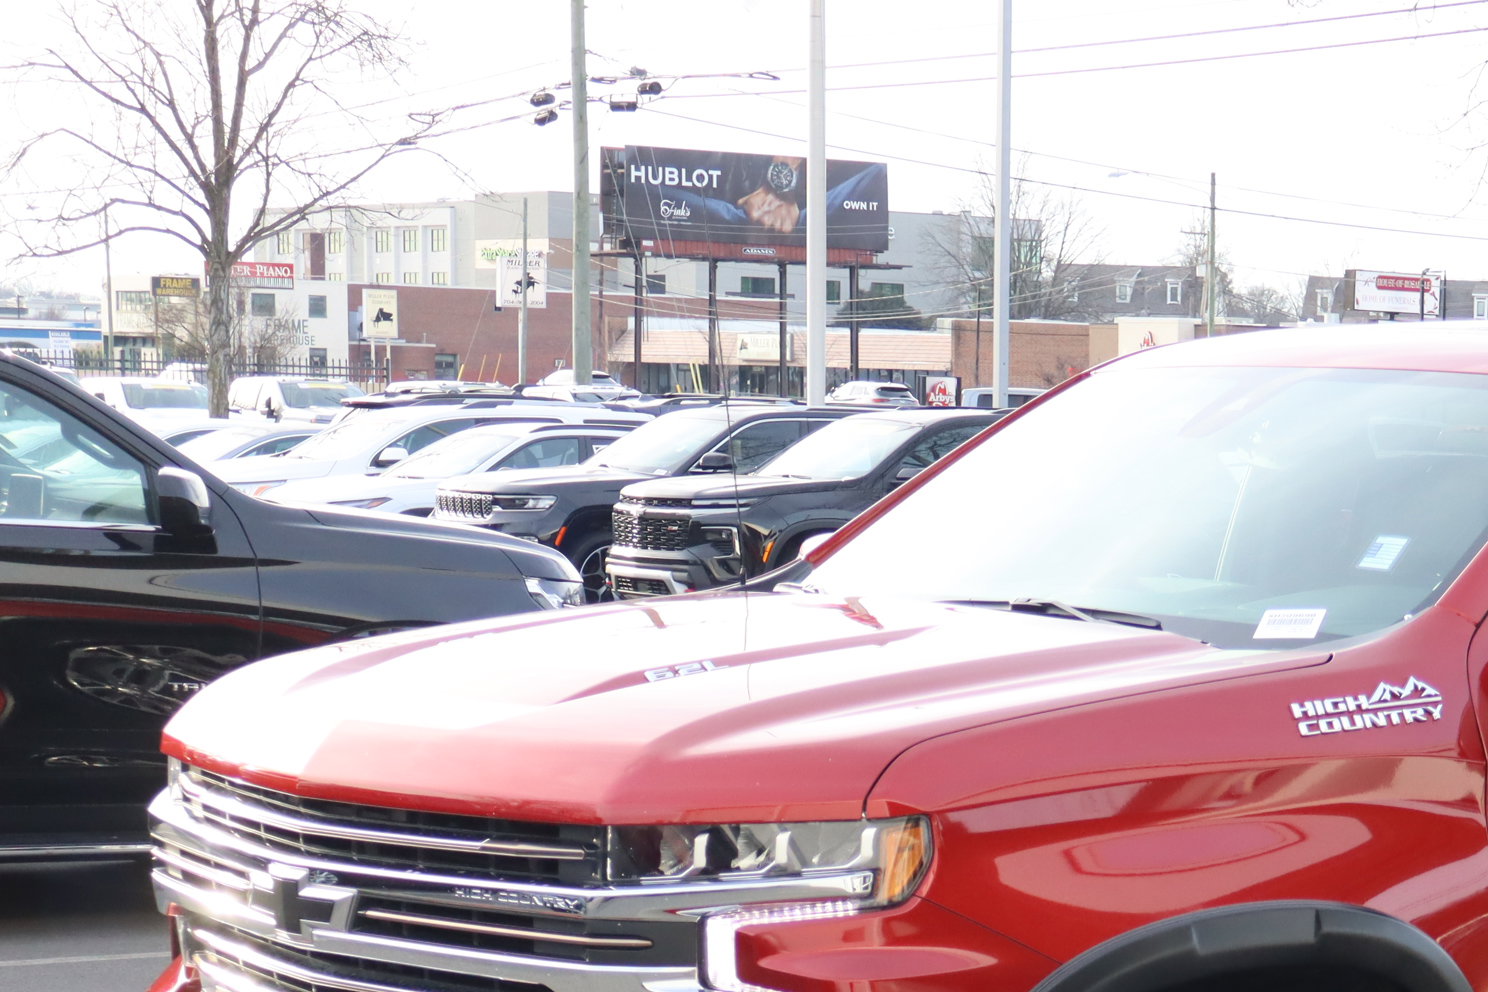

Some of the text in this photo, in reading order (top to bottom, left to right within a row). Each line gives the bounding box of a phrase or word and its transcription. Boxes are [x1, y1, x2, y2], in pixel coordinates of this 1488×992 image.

[630, 164, 722, 189] HUBLOT
[843, 200, 878, 211] OWN IT
[256, 264, 291, 277] PIANO
[506, 259, 541, 267] MILER
[160, 277, 192, 288] FRAME
[156, 288, 196, 297] WAREHOUSE
[265, 318, 309, 335] FRAME
[643, 659, 730, 683] 6.2L
[1290, 694, 1369, 719] HIGH
[1298, 704, 1443, 737] COUNTRY
[454, 887, 579, 909] HIGH COUNTRY
